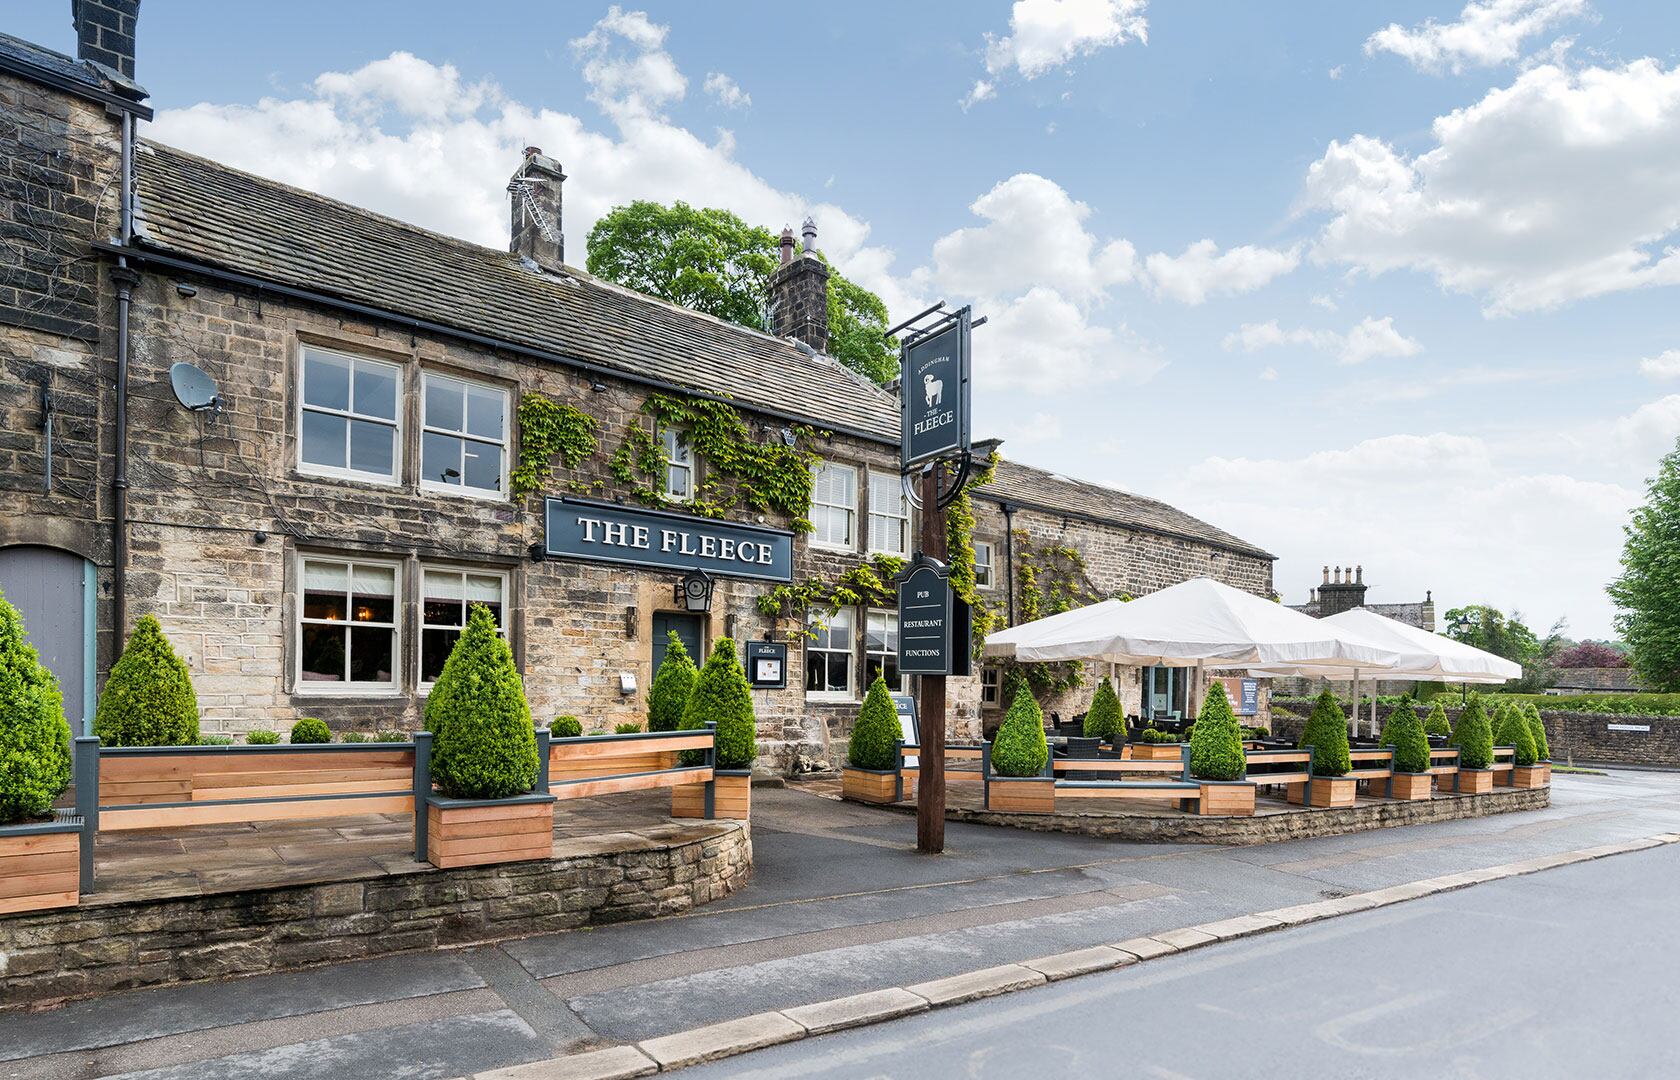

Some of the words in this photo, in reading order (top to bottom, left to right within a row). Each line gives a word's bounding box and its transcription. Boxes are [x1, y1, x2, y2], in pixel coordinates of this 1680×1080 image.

[918, 356, 950, 375] ADDINGHAM
[914, 410, 954, 436] FLEECE
[577, 517, 650, 549] THE
[661, 529, 773, 565] FLEECE
[917, 591, 930, 599] PUB
[903, 619, 943, 628] RESTAURANT
[905, 649, 940, 657] FUNCTIONS
